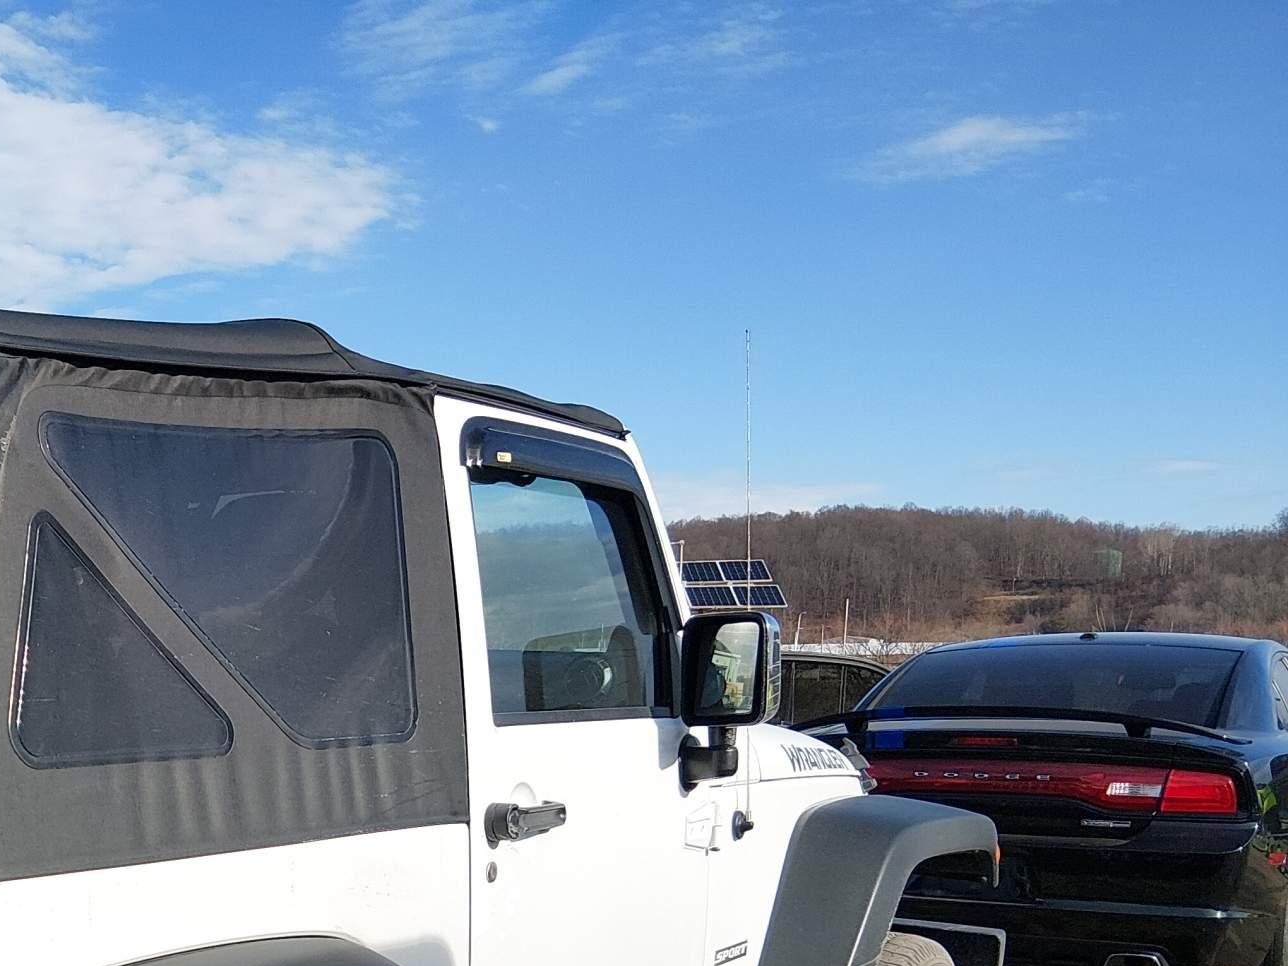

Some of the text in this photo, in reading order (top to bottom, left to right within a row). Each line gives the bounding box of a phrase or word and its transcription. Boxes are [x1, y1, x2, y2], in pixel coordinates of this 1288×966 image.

[779, 743, 850, 773] WRANGLER
[913, 771, 1051, 781] DODGE
[714, 941, 747, 966] SPORT
